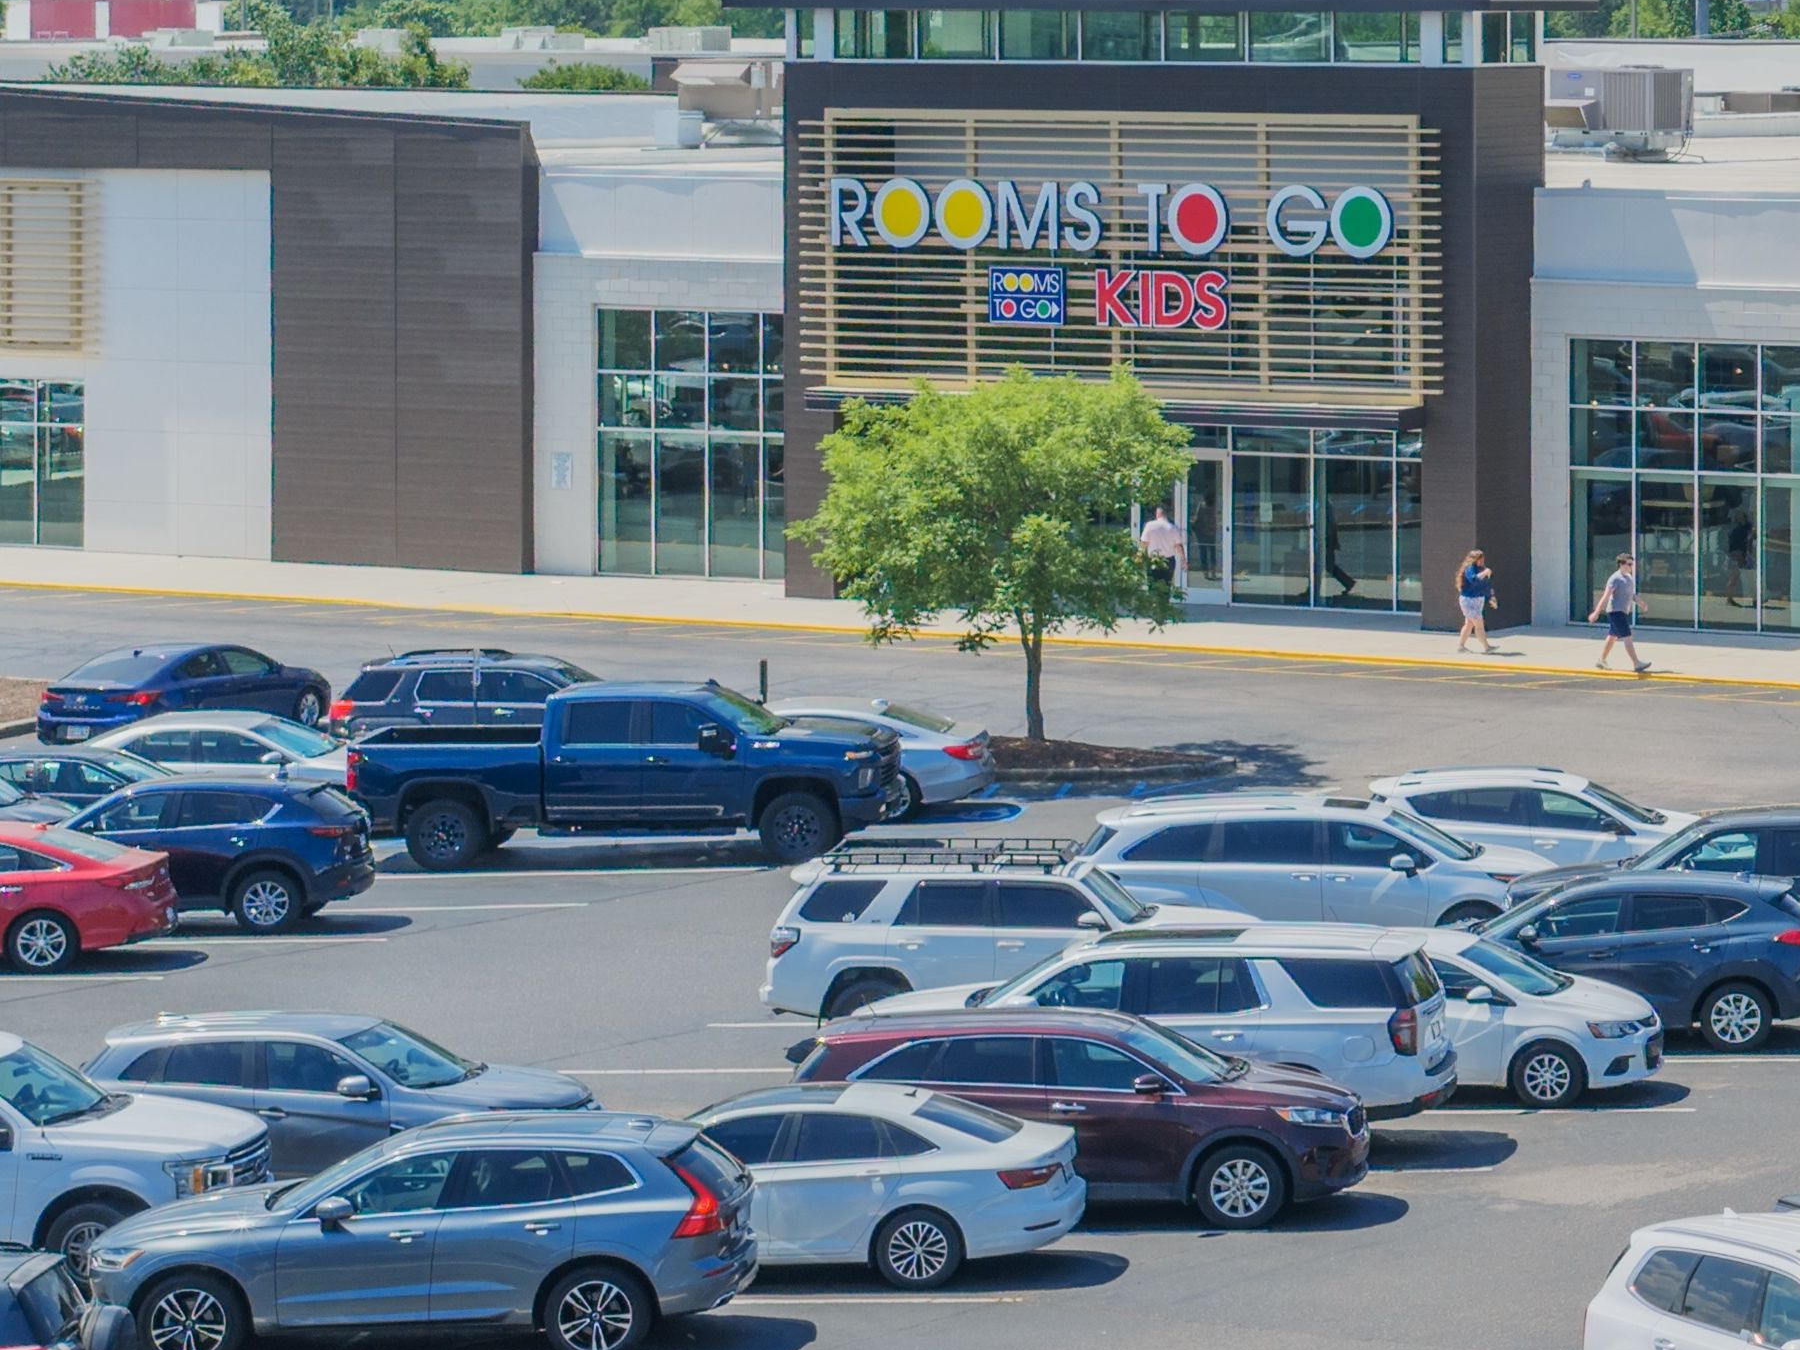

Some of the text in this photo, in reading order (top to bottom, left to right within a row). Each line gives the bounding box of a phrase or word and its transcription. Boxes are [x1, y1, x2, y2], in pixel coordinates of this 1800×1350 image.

[831, 178, 1393, 258] ROOMS TO GO
[993, 272, 1060, 293] ROOMS
[1095, 269, 1228, 330] KIDS
[993, 298, 1052, 319] TO GO
